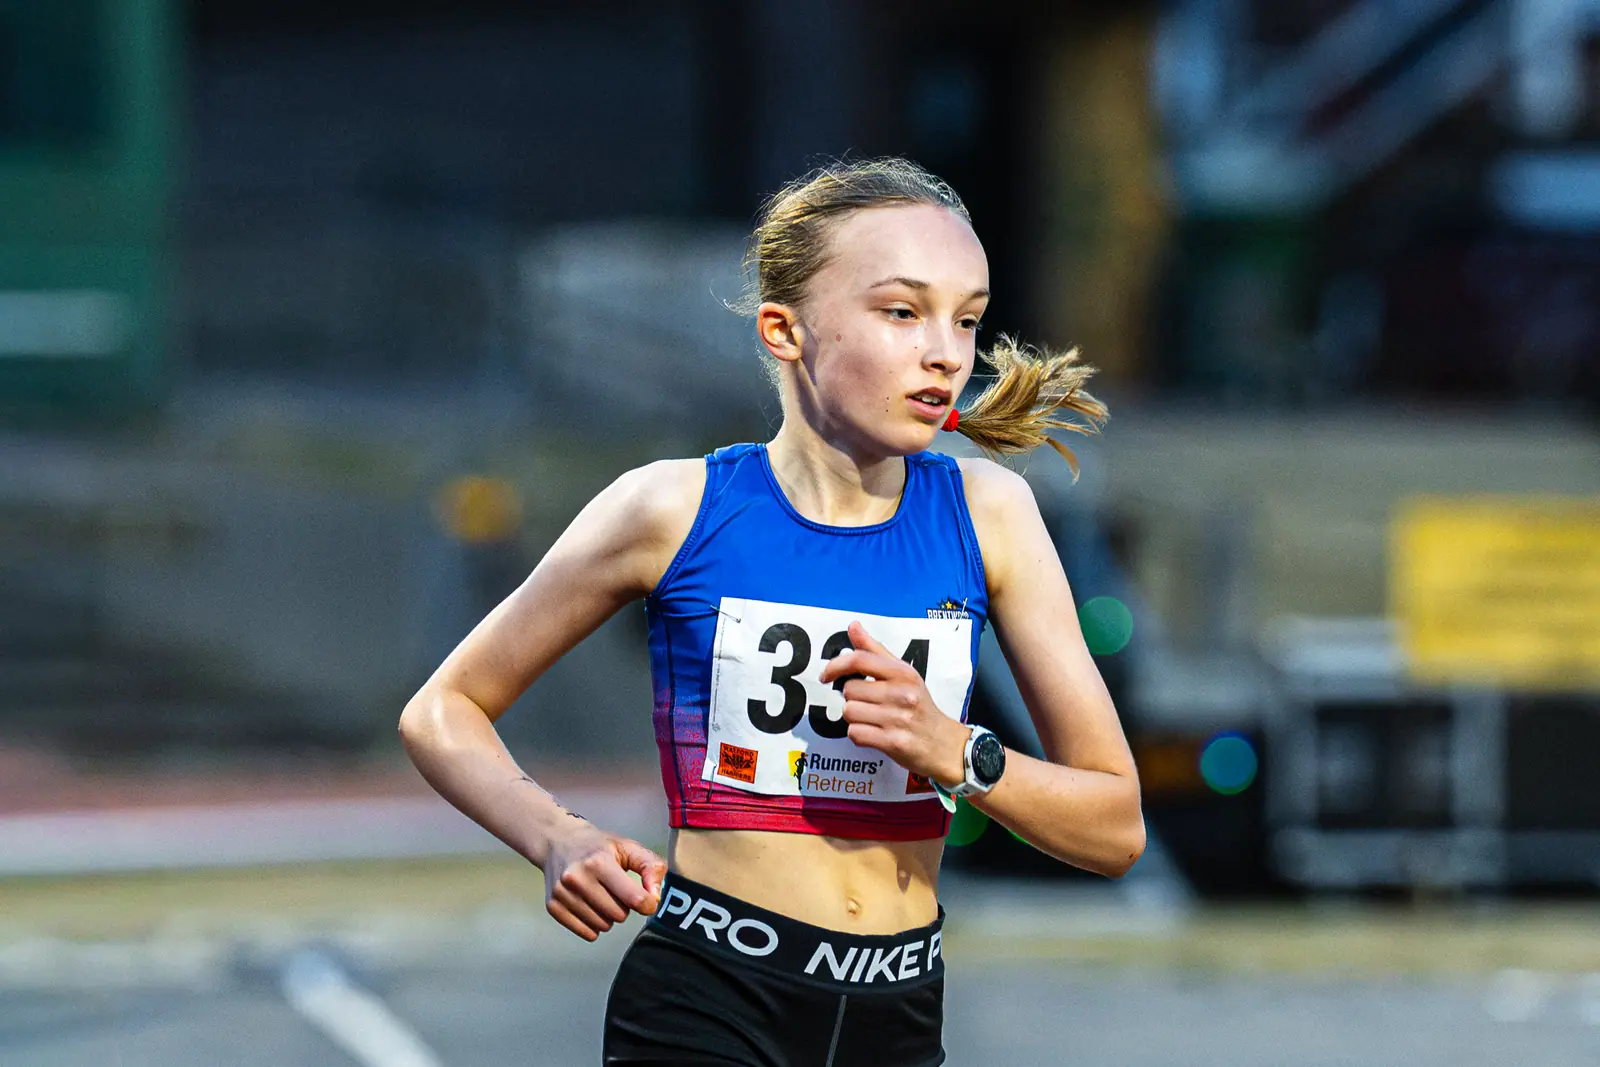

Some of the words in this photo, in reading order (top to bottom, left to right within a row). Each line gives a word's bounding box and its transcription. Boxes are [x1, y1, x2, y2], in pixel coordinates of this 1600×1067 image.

[806, 773, 874, 796] Retreat
[657, 886, 779, 957] PRO
[804, 940, 925, 983] NIKE
